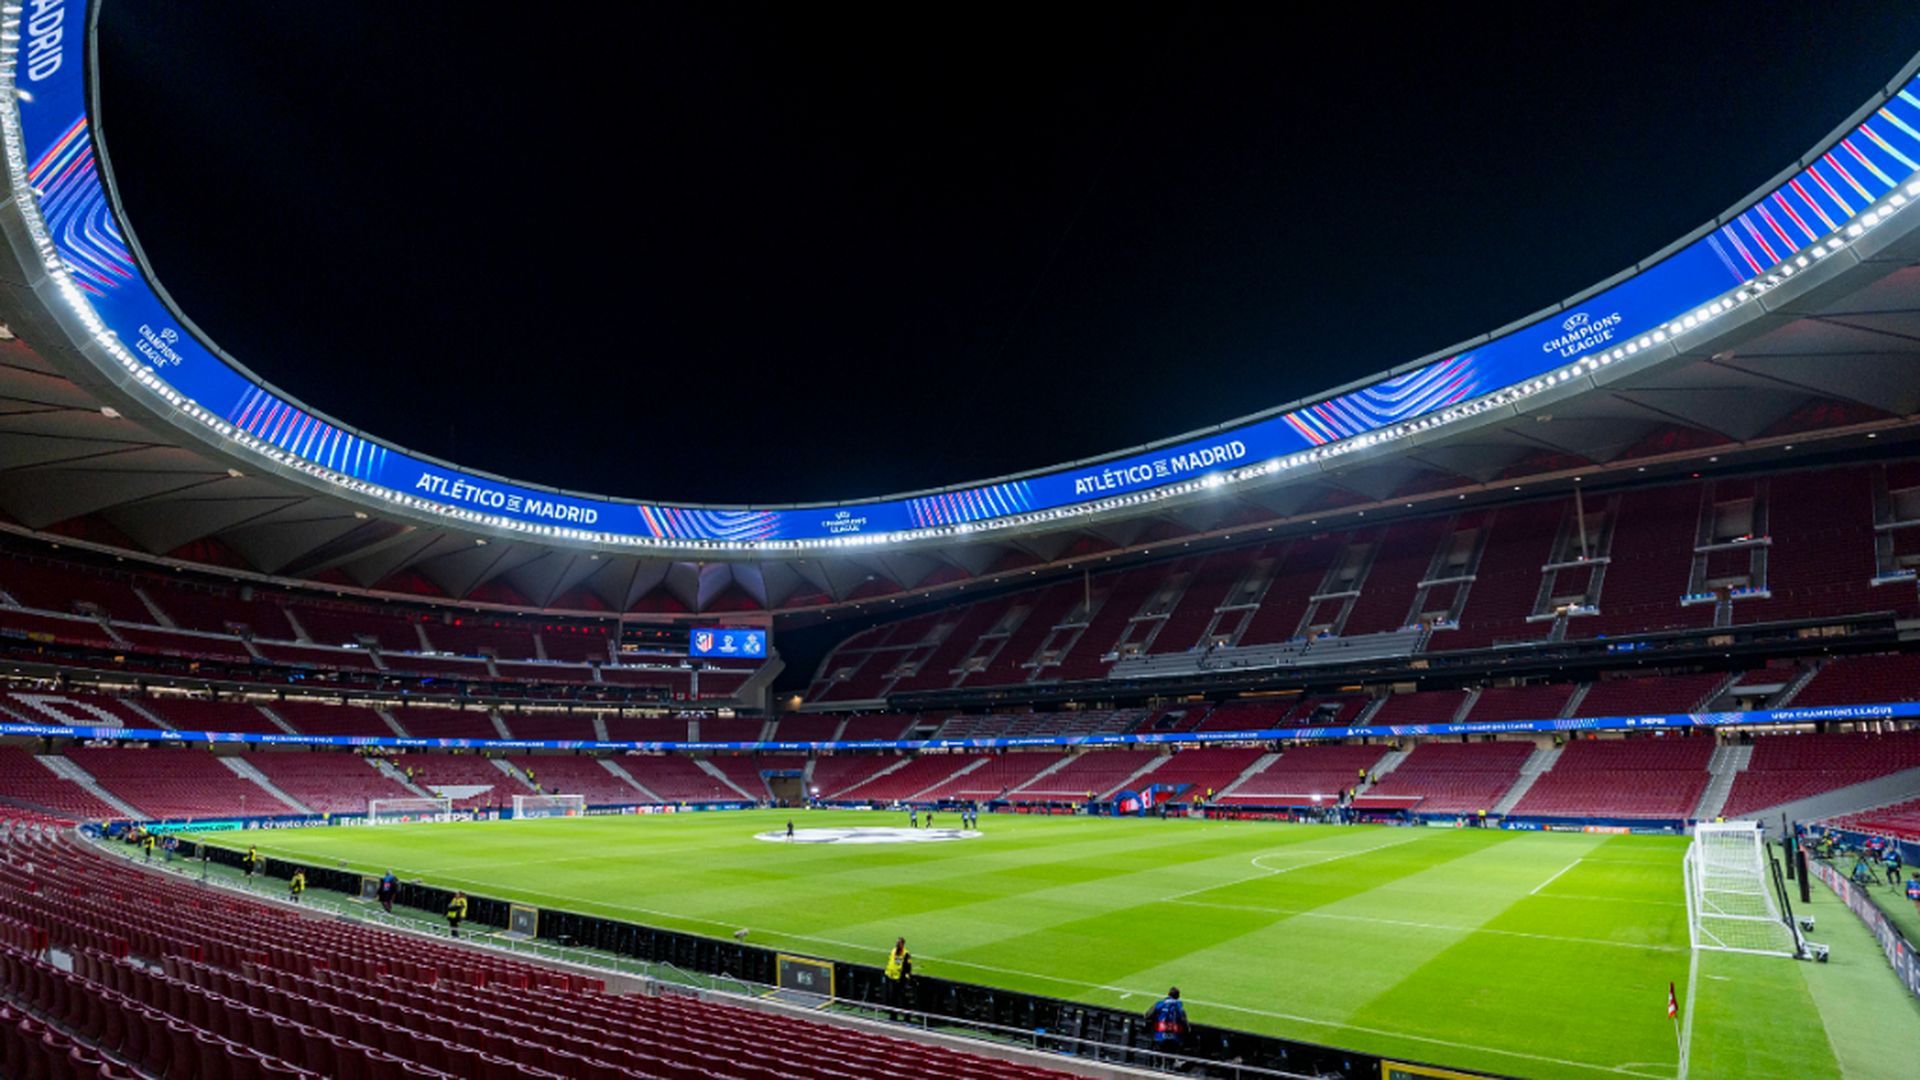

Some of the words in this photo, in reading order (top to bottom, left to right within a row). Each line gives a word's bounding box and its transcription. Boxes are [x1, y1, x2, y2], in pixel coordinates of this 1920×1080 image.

[139, 324, 183, 366] CHAMPIONS
[1543, 312, 1622, 353] CHAMPIONS
[1560, 329, 1613, 357] LEAGUE
[136, 339, 167, 368] LEAGUE
[1075, 464, 1154, 494] ATLÉTICO
[1171, 441, 1246, 473] MADRID
[416, 473, 505, 508] ATLÉTICO
[523, 498, 598, 524] MADRID
[1796, 708, 1852, 718] CHAMPIONS
[1854, 706, 1892, 715] LEAGUE
[262, 820, 329, 830] crypto.com
[340, 816, 399, 826] Heinken
